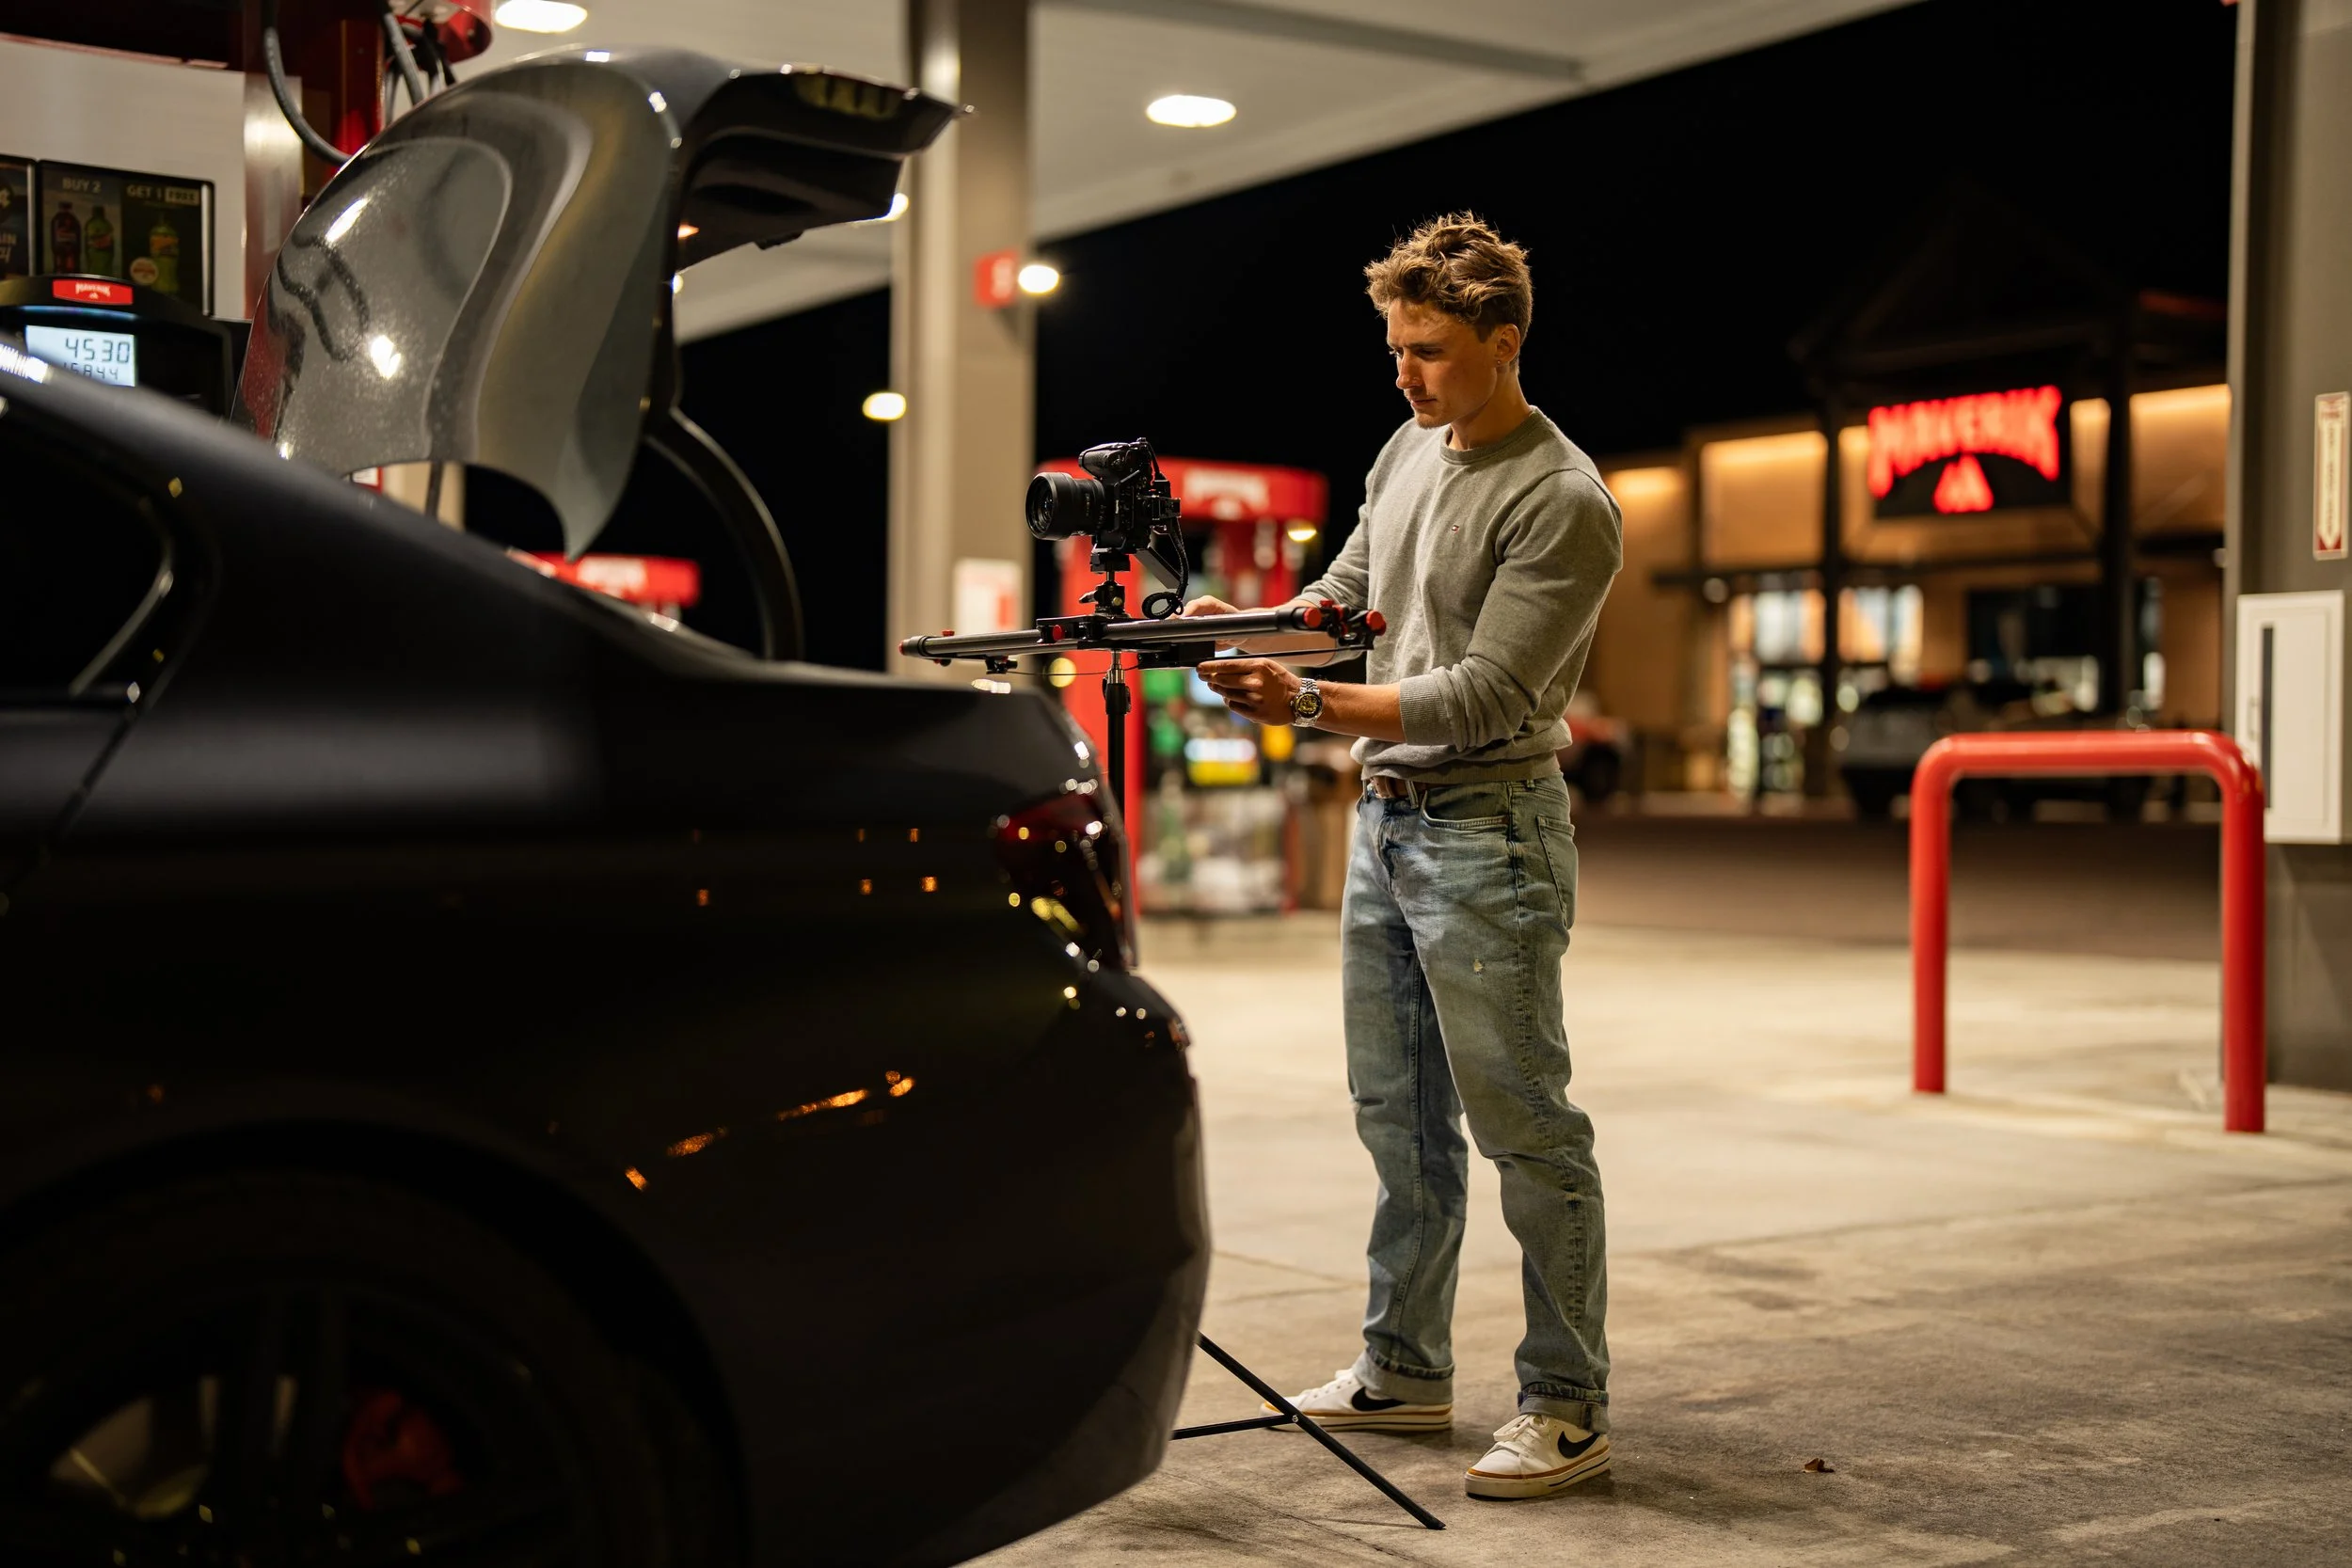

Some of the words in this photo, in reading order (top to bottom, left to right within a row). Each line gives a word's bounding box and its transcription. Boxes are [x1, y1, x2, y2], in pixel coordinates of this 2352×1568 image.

[62, 177, 90, 192] BUY
[92, 180, 102, 194] 2
[126, 183, 153, 200] GET
